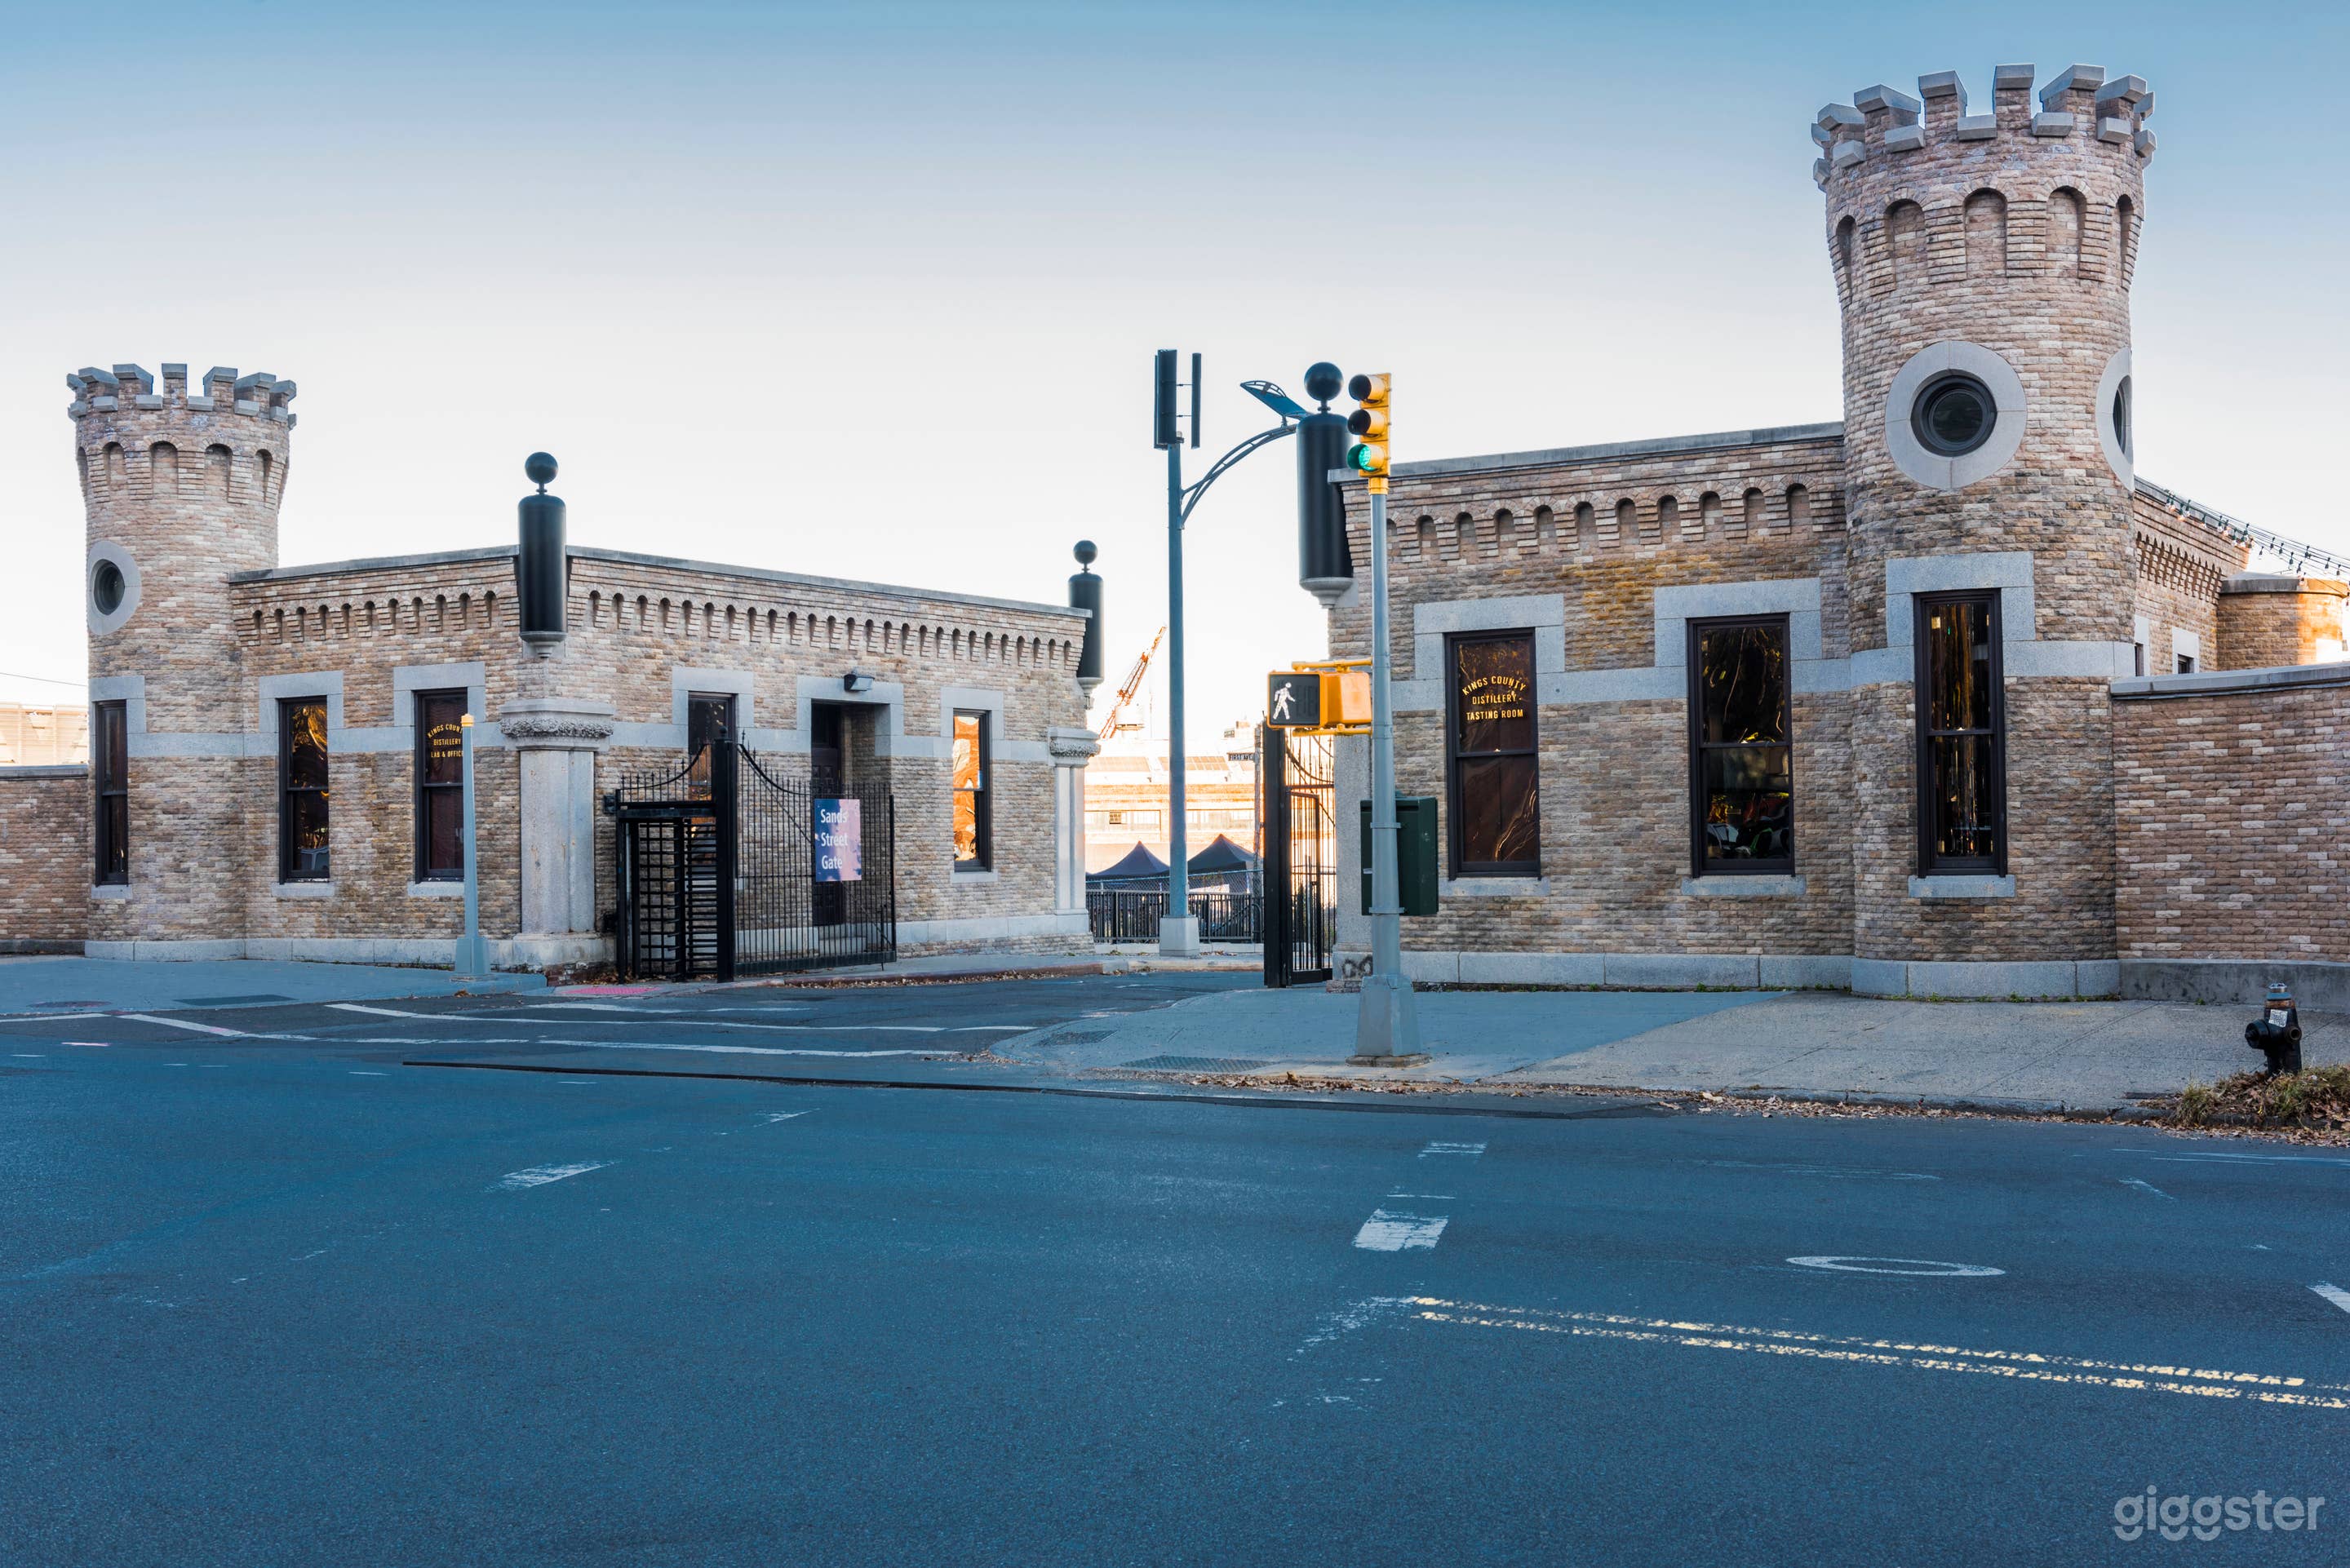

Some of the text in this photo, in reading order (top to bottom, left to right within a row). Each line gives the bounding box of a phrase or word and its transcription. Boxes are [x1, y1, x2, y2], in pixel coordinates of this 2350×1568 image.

[1462, 675, 1526, 695] KINGS COUNTY
[1472, 693, 1517, 705] DISTILLERY
[1466, 709, 1523, 720] TASTING ROOM
[427, 724, 463, 738] KINGS COUN
[433, 737, 461, 746] DISTILLERY
[820, 808, 848, 823] Sands
[821, 832, 848, 847] Street
[822, 855, 843, 870] Gate
